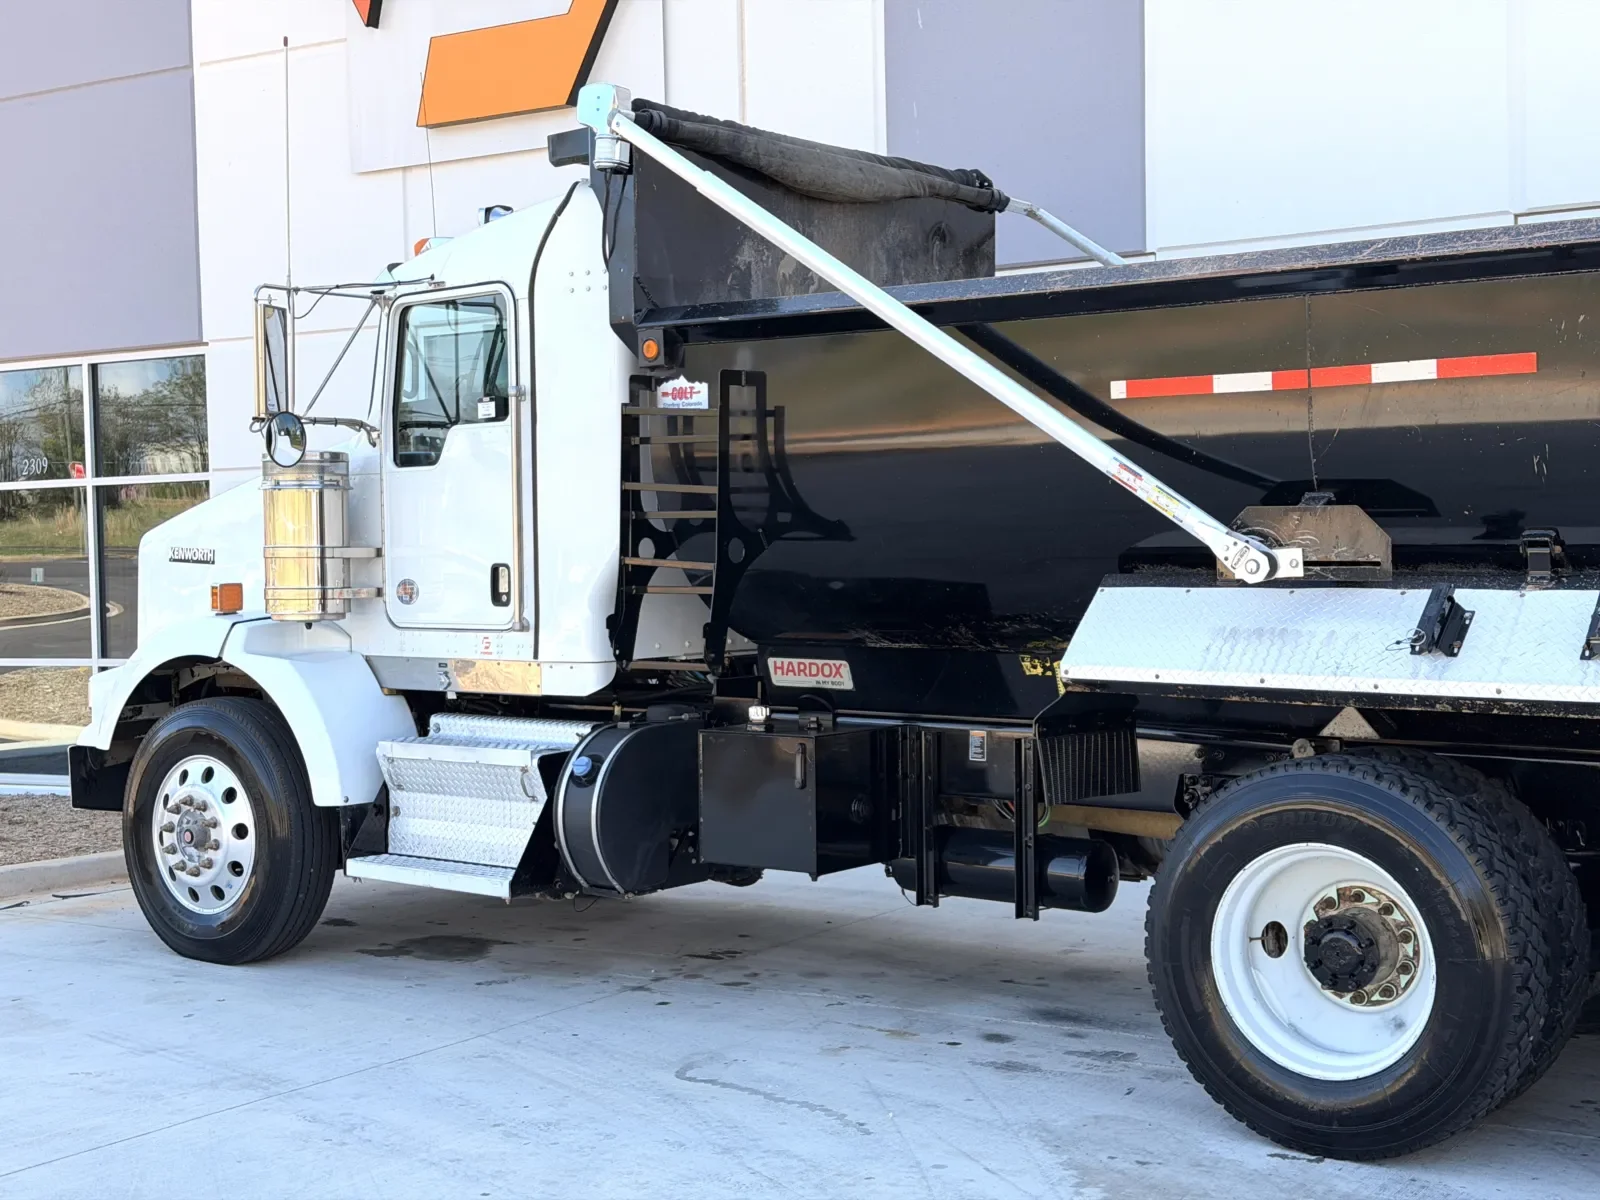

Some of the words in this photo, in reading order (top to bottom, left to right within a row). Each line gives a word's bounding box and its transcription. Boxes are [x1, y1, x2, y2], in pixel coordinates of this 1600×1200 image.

[22, 457, 48, 475] 2309
[169, 546, 214, 562] KENWORTH
[773, 660, 844, 679] HARDOX
